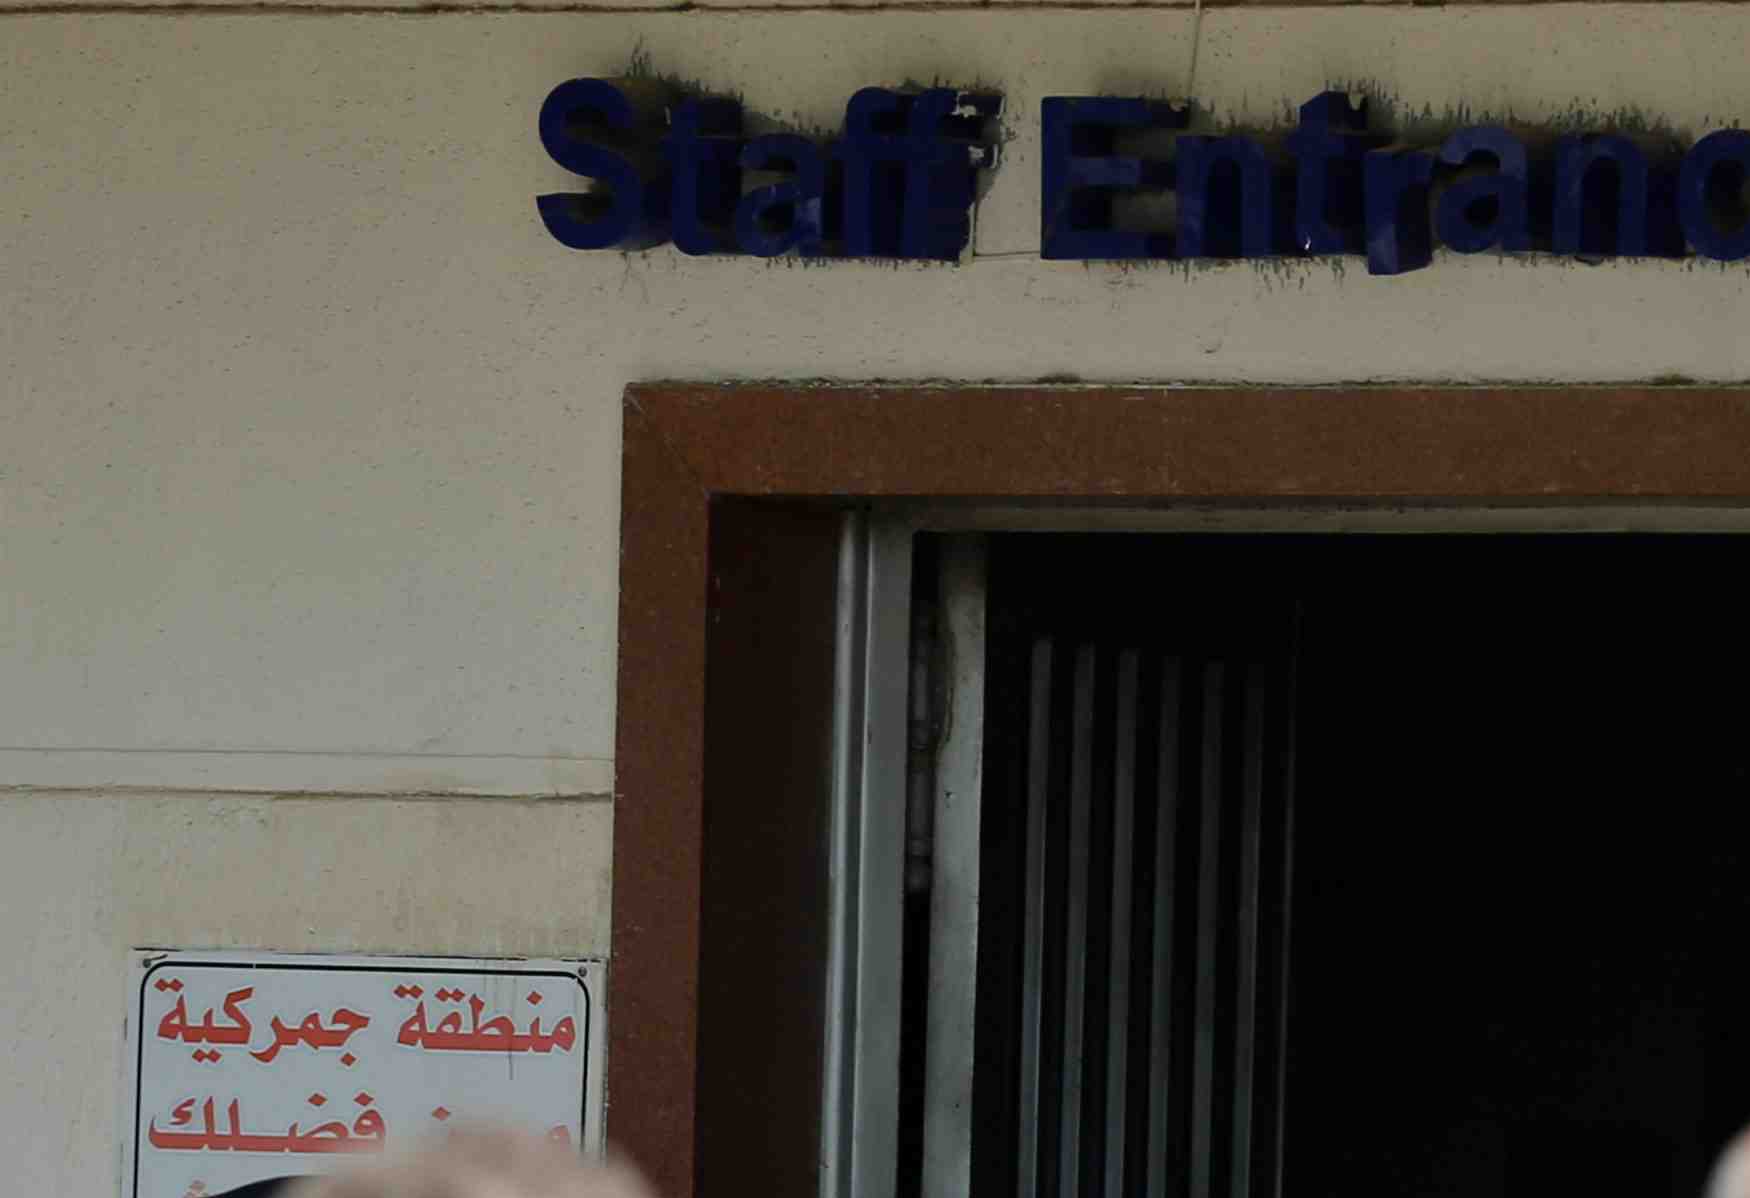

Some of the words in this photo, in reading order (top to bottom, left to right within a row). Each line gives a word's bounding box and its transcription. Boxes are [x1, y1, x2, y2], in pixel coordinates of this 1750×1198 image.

[536, 77, 1002, 259] Staff
[154, 977, 371, 1067] جمركية
[393, 984, 577, 1054] منطقة
[148, 1091, 386, 1153] فضلك
